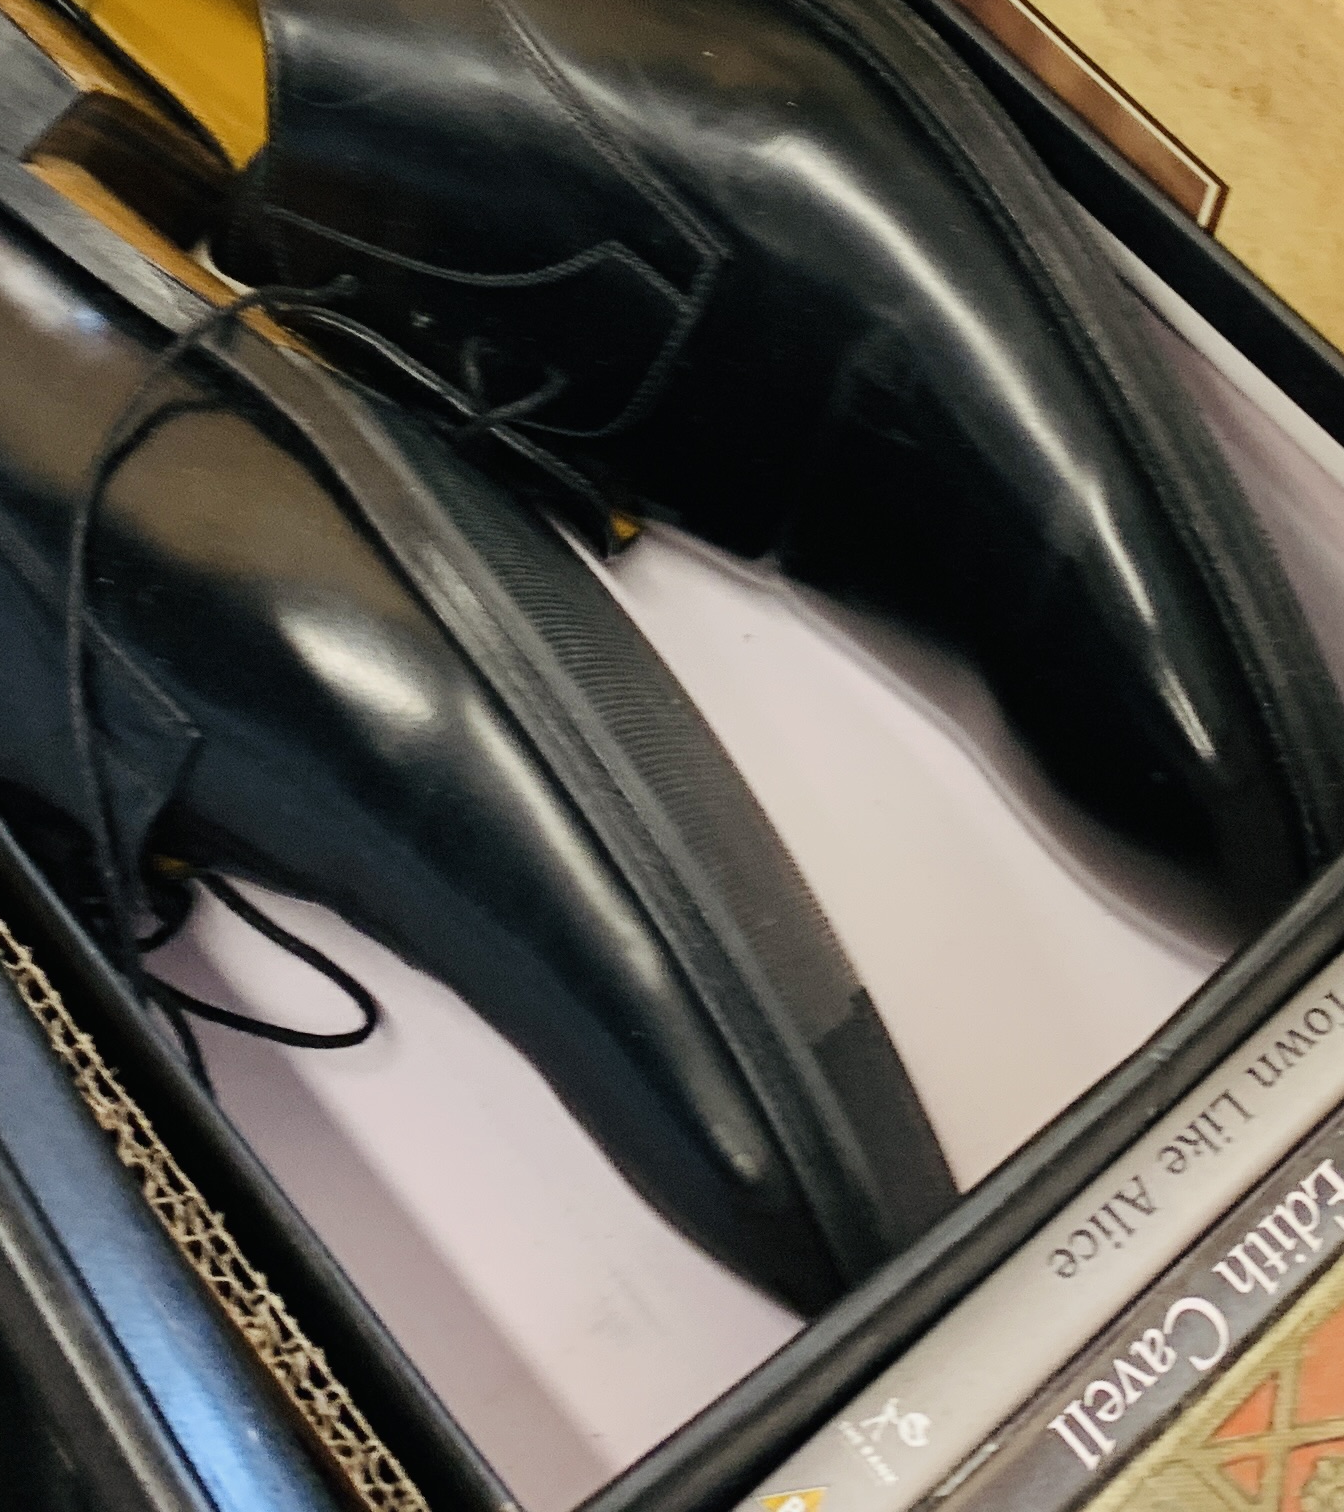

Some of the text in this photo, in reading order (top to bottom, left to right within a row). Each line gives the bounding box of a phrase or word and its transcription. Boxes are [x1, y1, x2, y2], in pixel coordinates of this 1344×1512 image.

[1154, 1090, 1257, 1178] Like
[1047, 1173, 1165, 1282] Alice
[1047, 1295, 1231, 1473] Cavell
